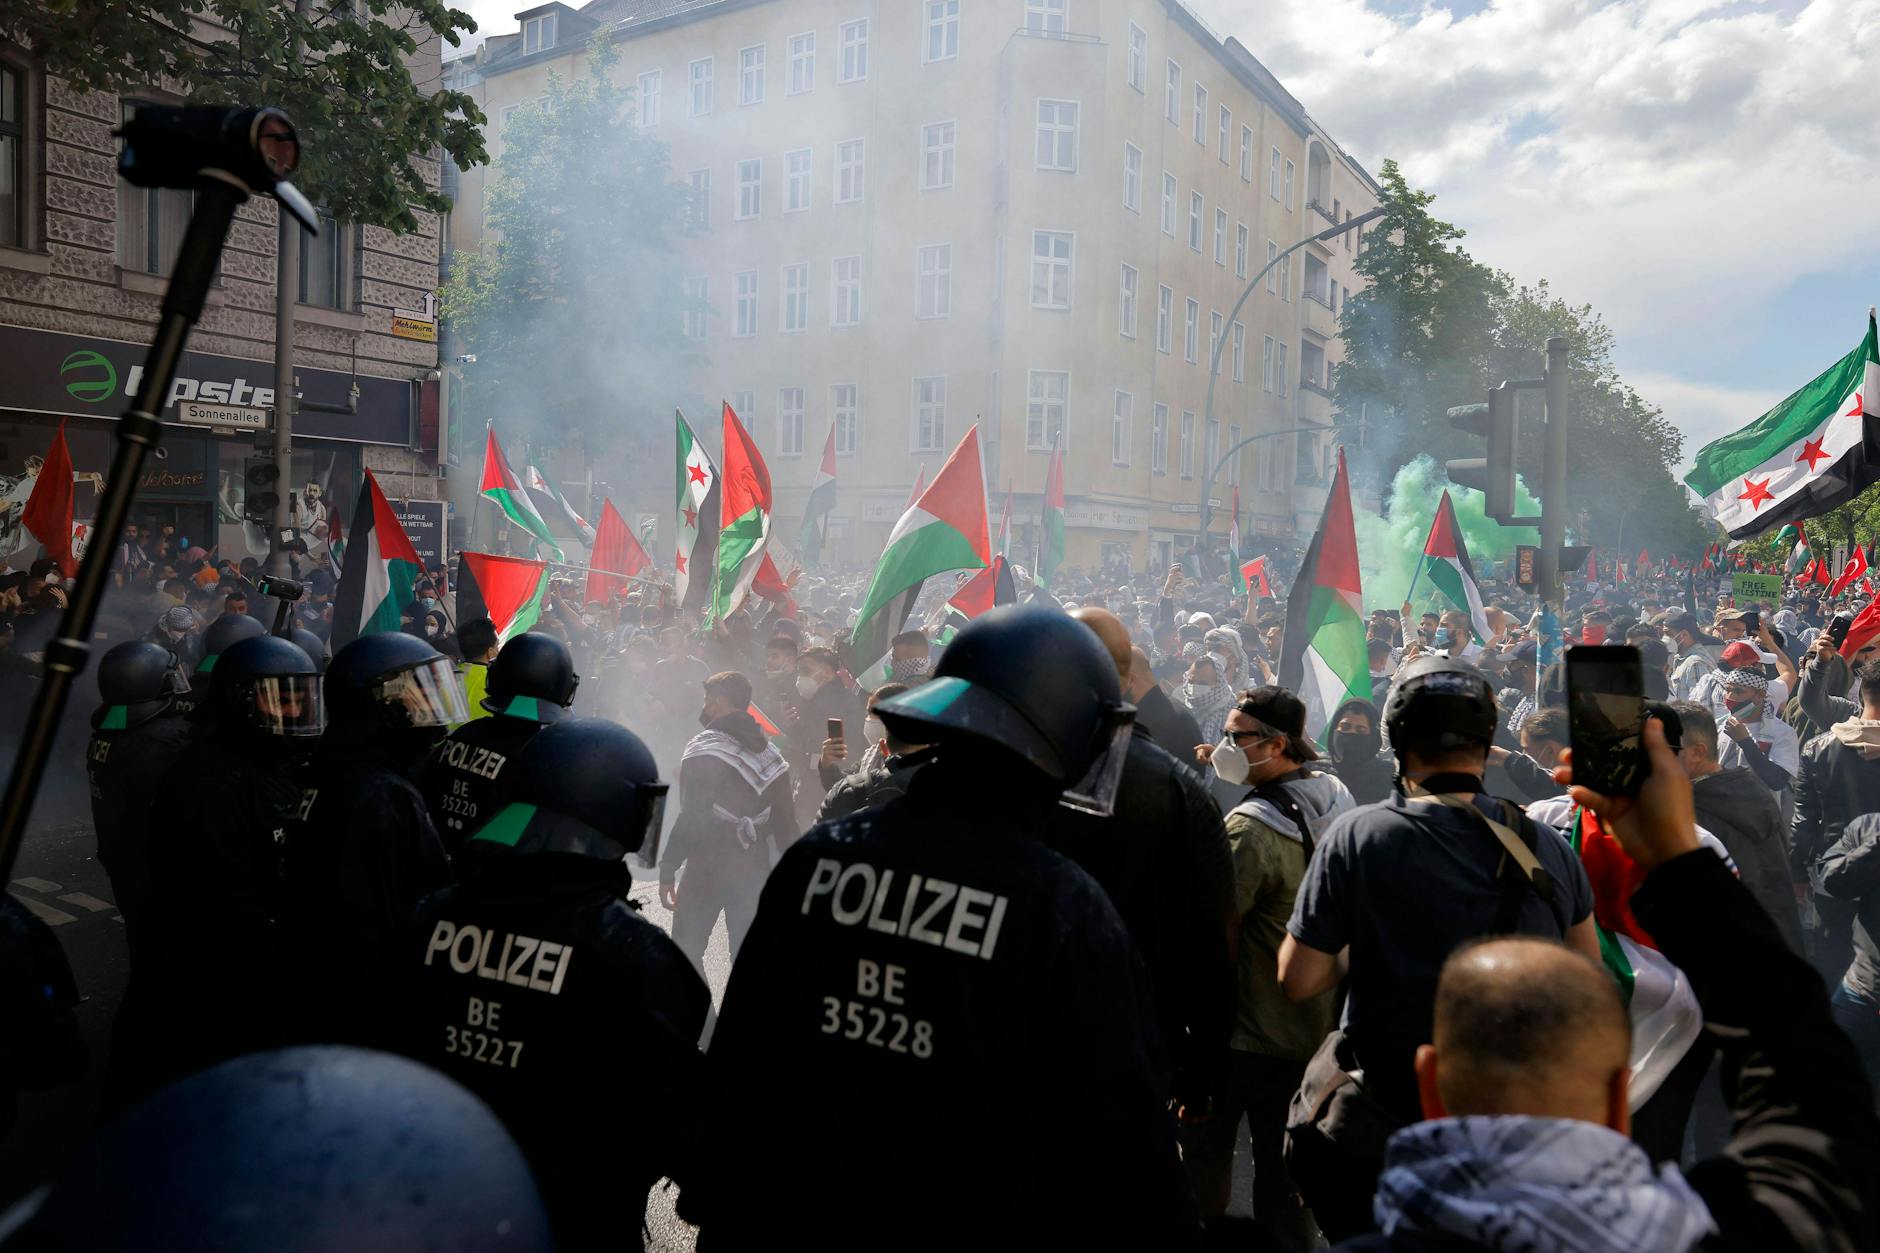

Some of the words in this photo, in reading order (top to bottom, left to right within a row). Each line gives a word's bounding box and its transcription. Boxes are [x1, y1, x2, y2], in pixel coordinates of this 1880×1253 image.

[189, 406, 259, 423] Sonnenallee
[1742, 581, 1767, 590] FREE
[438, 739, 507, 780] POLIZEI
[441, 794, 477, 818] 35220
[453, 779, 469, 798] BE
[801, 858, 1008, 960] POLIZEI
[424, 920, 573, 995] POLIZEI
[857, 958, 906, 1005] BE
[467, 996, 502, 1031] BE
[821, 996, 933, 1059] 35228
[445, 1025, 524, 1068] 35227
